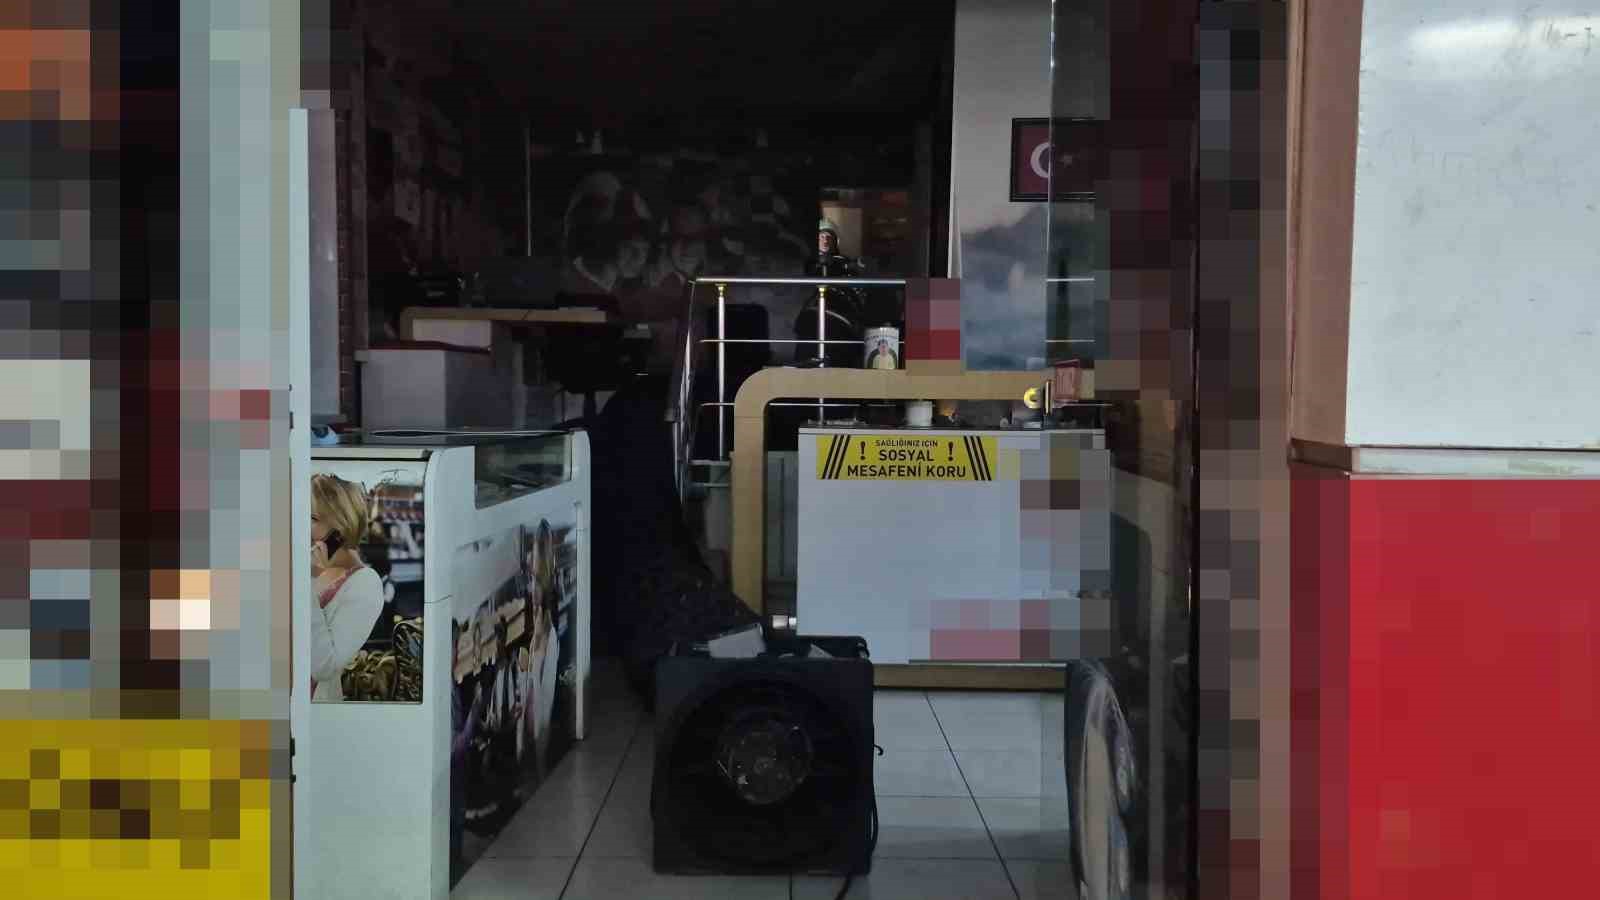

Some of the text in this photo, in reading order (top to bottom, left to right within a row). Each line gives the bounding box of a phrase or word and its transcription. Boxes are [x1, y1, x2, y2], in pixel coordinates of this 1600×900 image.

[879, 449, 934, 461] SOSYAL
[847, 462, 966, 478] MESAFENİ KORU
